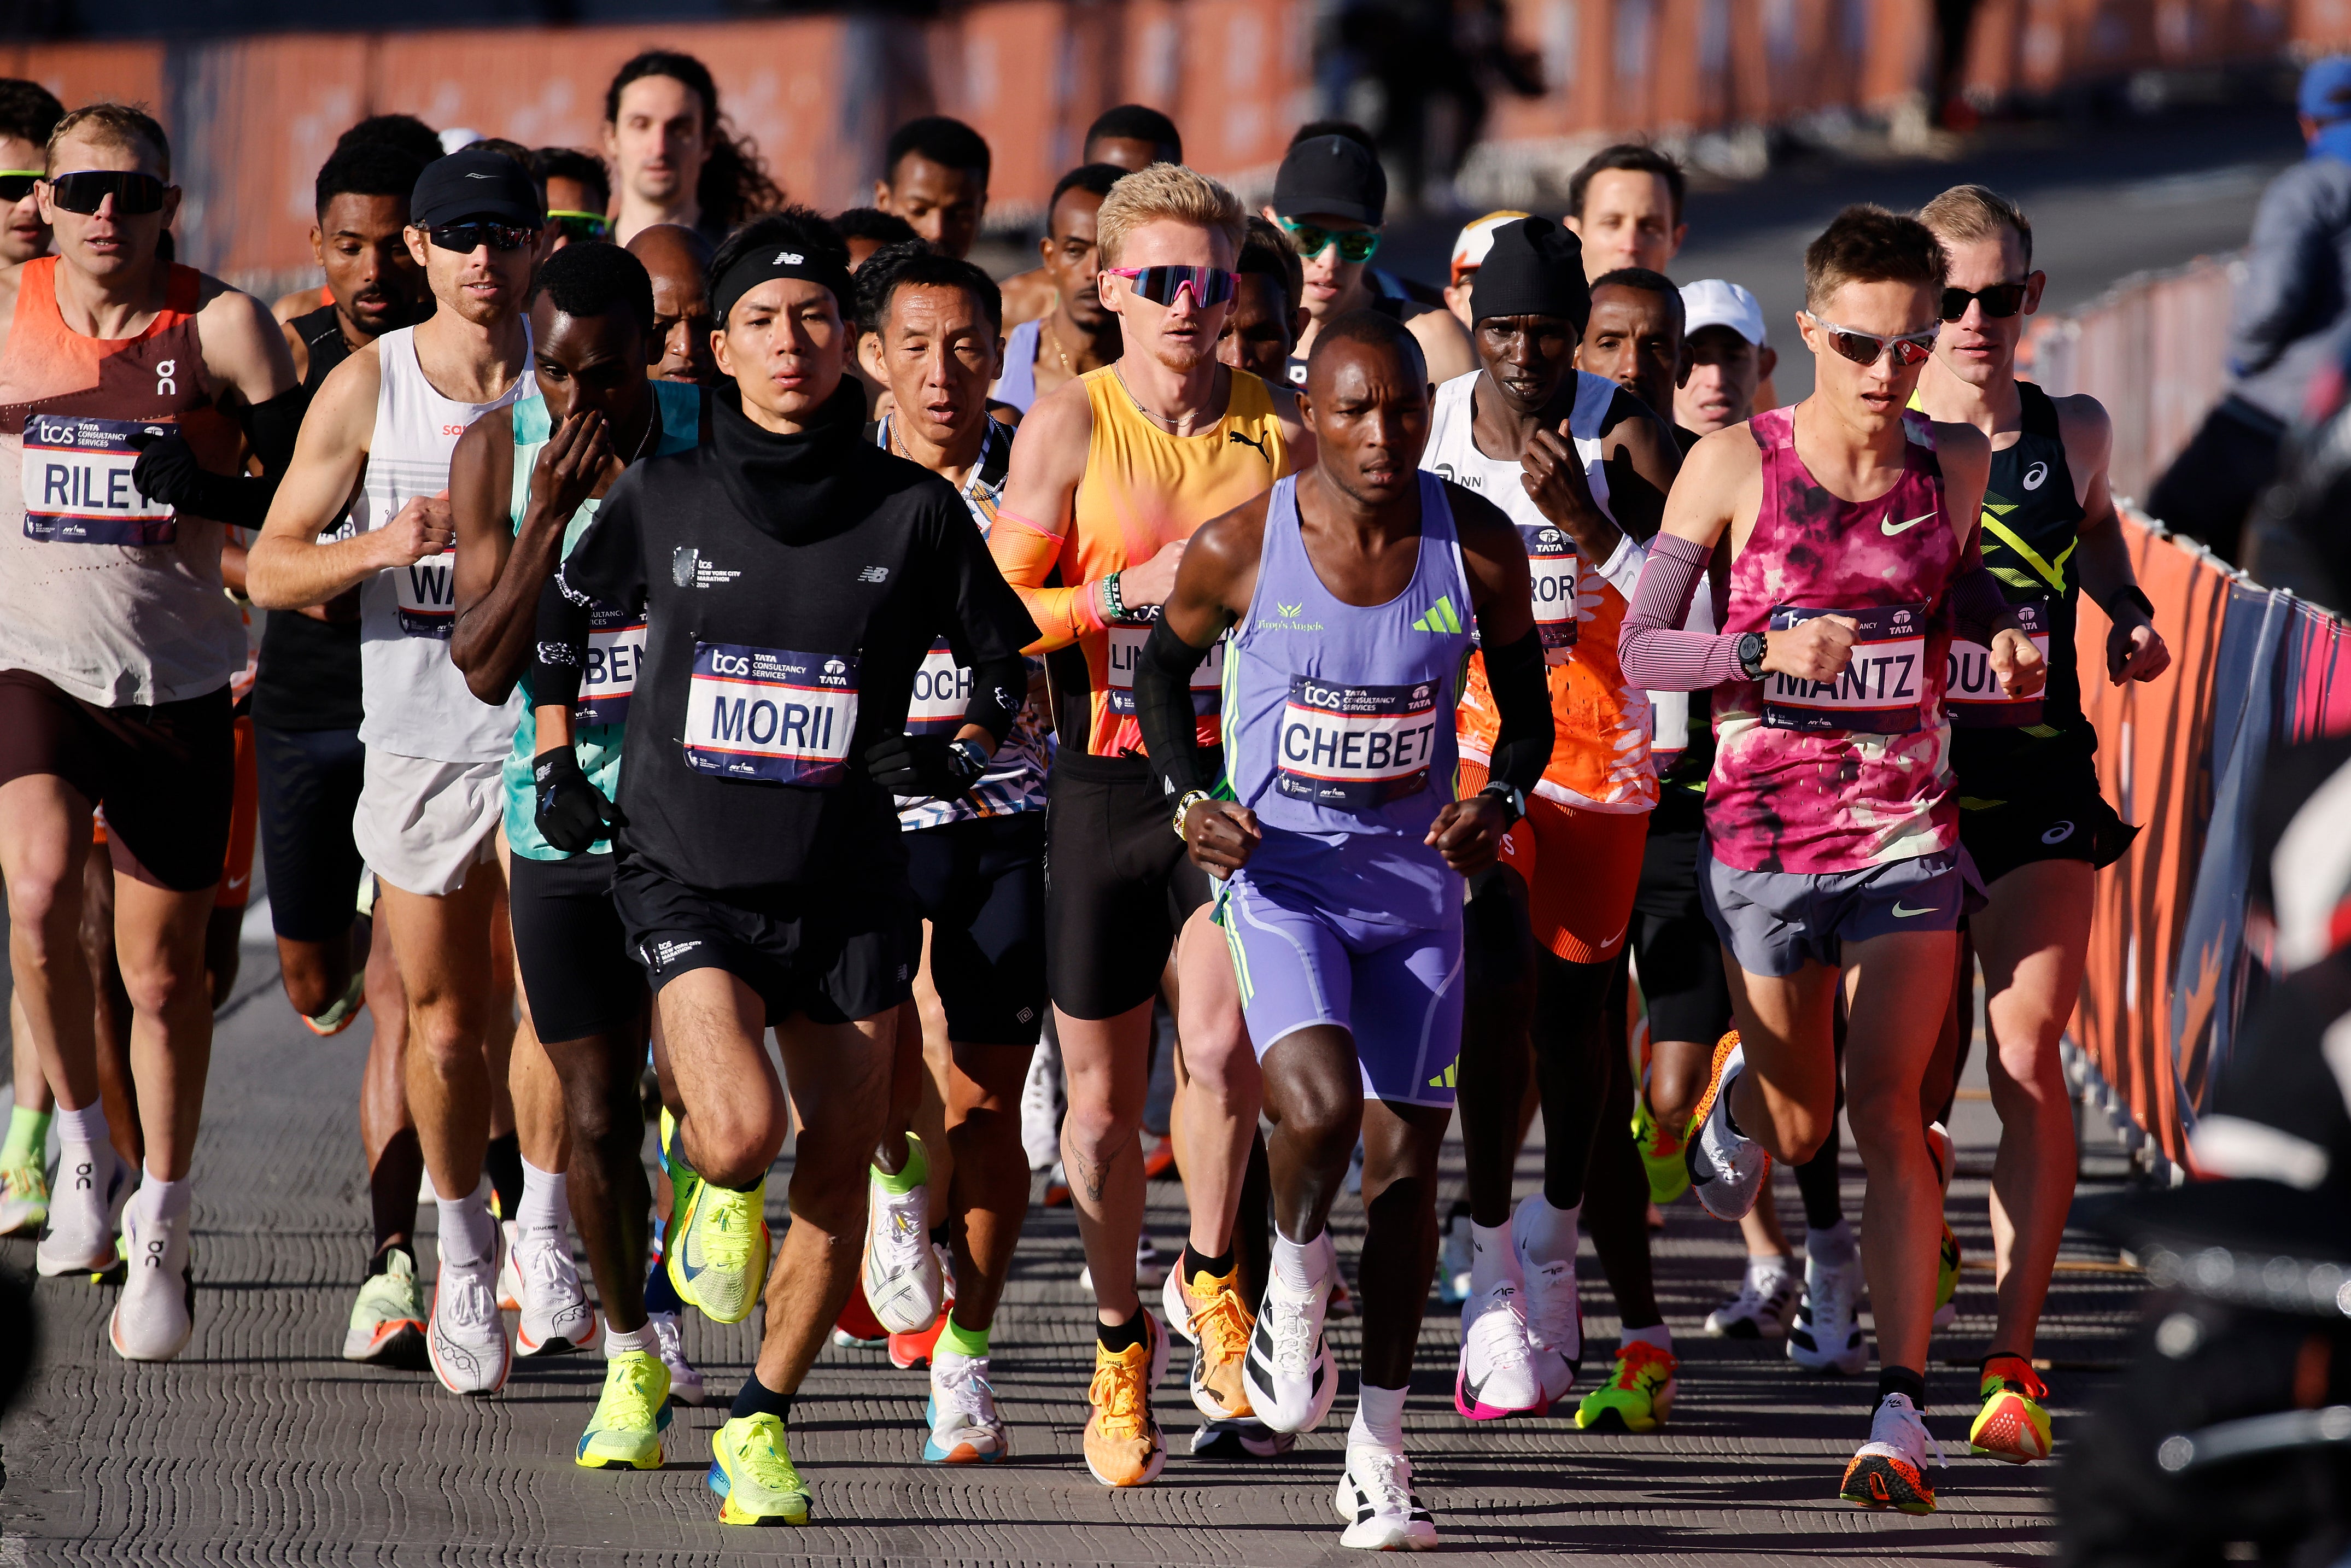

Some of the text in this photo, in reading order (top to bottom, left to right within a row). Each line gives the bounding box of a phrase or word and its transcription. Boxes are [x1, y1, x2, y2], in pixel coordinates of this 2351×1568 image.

[40, 420, 74, 444] tcs
[78, 423, 99, 431] TATA
[442, 424, 466, 436] sa
[77, 431, 127, 441] CONSULTANCY
[77, 438, 109, 447] SERVICES
[44, 463, 153, 508] RILE
[1461, 476, 1481, 487] NN
[1535, 544, 1563, 552] TATA
[698, 559, 712, 569] tcs
[410, 565, 455, 604] W
[1257, 619, 1323, 631] Tirop's Angels
[1890, 625, 1913, 634] TATA
[712, 650, 749, 675] tcs
[754, 654, 776, 663] TATA
[753, 662, 806, 674] CONSULTANCY
[752, 669, 786, 679] SERVICES
[819, 676, 847, 685] TATA
[1304, 685, 1340, 709] tcs
[1343, 696, 1395, 704] CONSULTANCY
[1408, 700, 1431, 709] TATA
[711, 695, 834, 750] MORII
[1285, 722, 1434, 769] CHEBET
[658, 940, 672, 950] tcs
[661, 946, 692, 960] MARATHON
